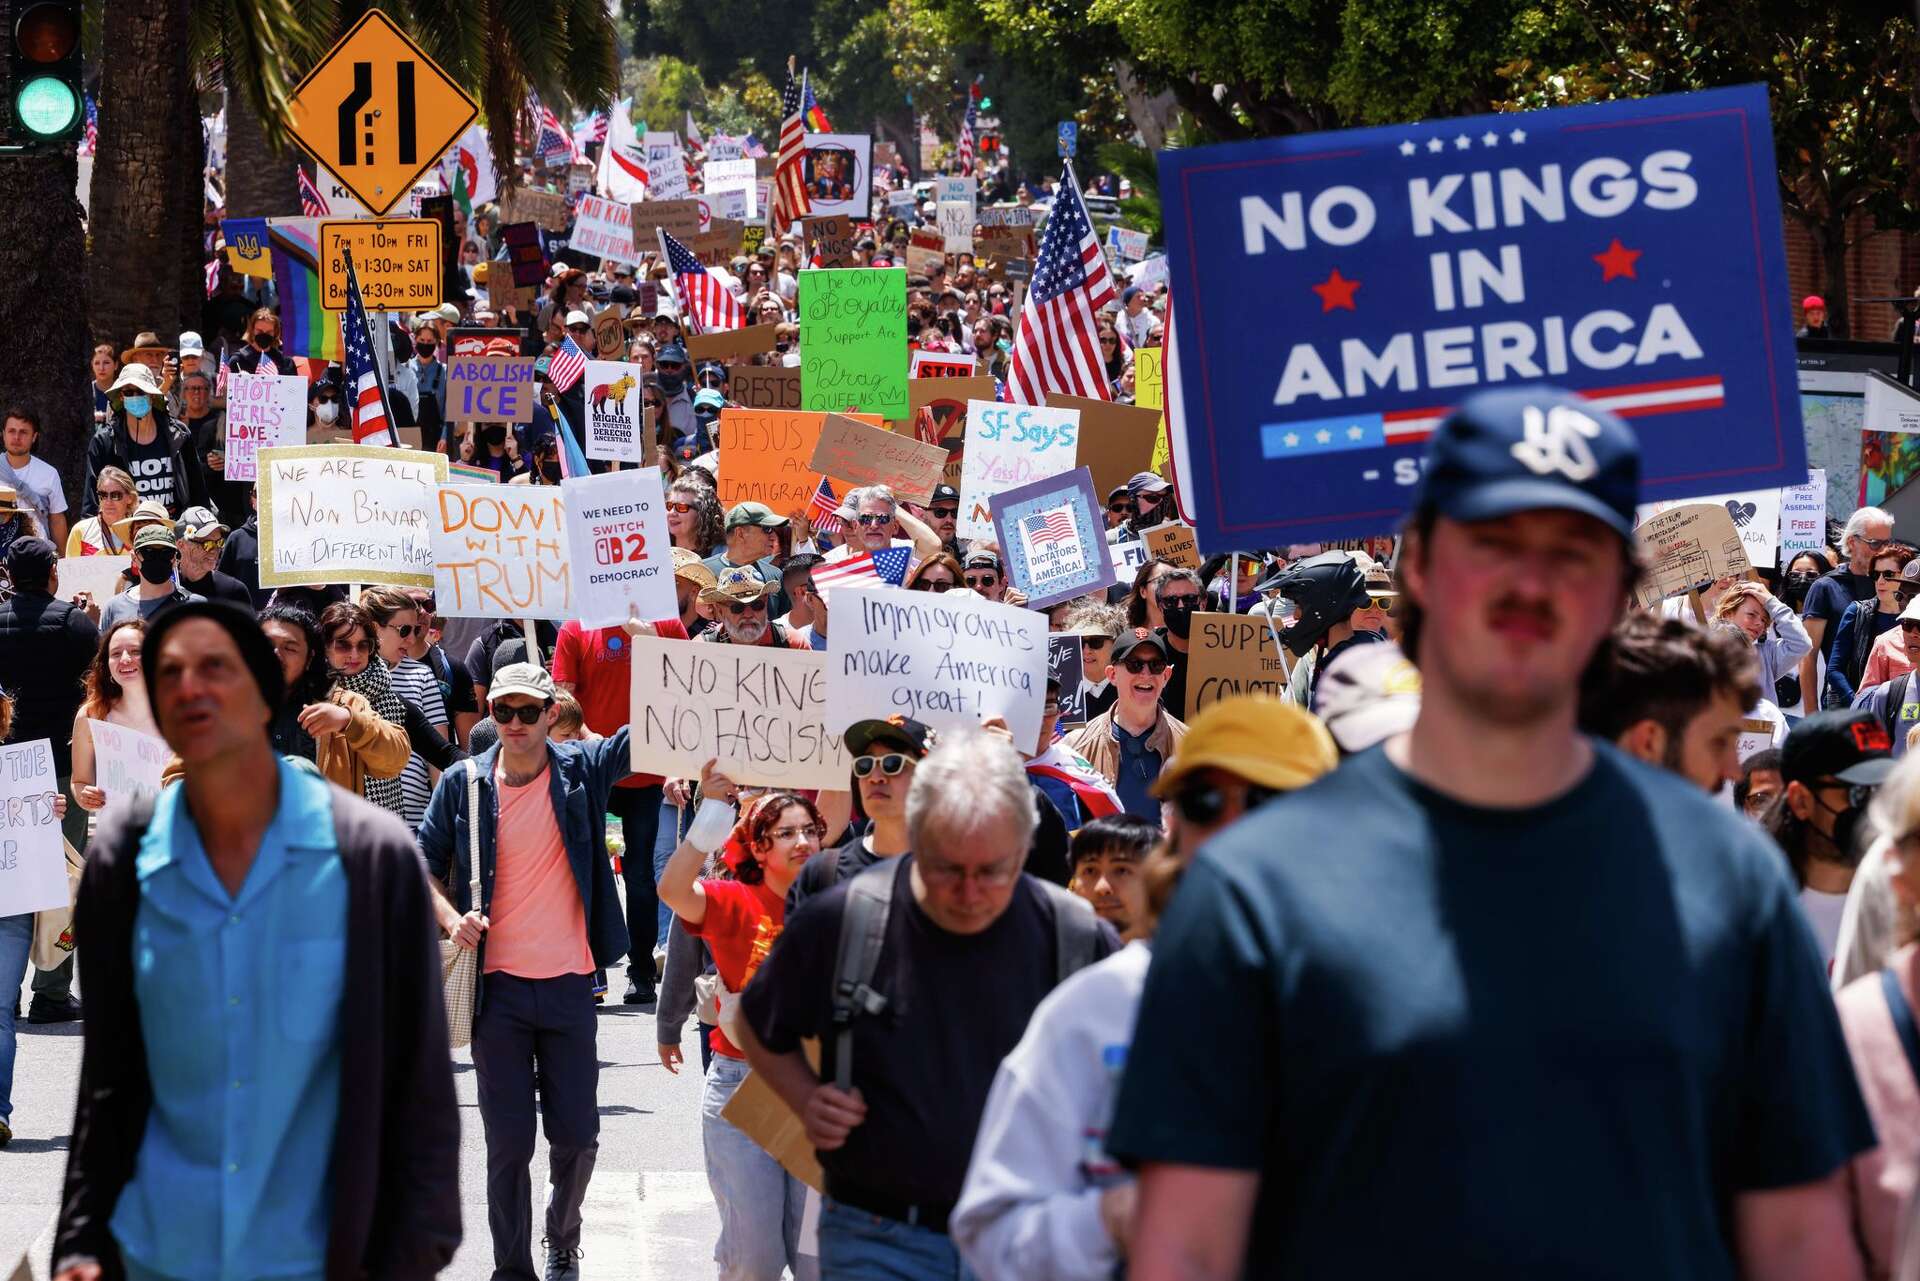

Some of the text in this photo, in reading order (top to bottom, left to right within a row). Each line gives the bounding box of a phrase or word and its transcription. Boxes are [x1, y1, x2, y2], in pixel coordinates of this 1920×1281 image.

[583, 199, 602, 218] NO
[1239, 149, 1698, 255] NO KINGS
[812, 220, 838, 237] NO
[333, 234, 351, 249] 7PM
[371, 233, 398, 249] 10PM
[407, 234, 428, 249] FRI
[364, 258, 403, 273] 1:30PM
[408, 259, 430, 273] SAT
[800, 269, 889, 294] The Only
[1430, 244, 1525, 311] IN
[362, 283, 404, 298] 4:30PM
[409, 284, 433, 298] SUN
[803, 325, 897, 347] I Support Are
[1273, 303, 1704, 406] AMERICA
[451, 362, 533, 383] ABOLISH
[806, 356, 889, 391] Drag
[920, 364, 969, 378] STOP
[233, 379, 274, 402] HOT
[463, 385, 517, 416] ICE
[732, 375, 801, 407] RESIS
[809, 392, 873, 412] QUEENS
[229, 402, 281, 427] GIRLS
[592, 413, 632, 424] MIGRAR
[229, 423, 267, 441] LOVE
[593, 428, 632, 438] DERECHO
[602, 422, 632, 430] NUESTRO
[727, 417, 802, 451] JESUS
[979, 409, 1075, 452] SF Says
[594, 436, 632, 444] ANCESTRAL
[128, 457, 173, 477] NOT
[226, 462, 257, 480] NEI
[276, 459, 427, 486] WE ARE ALL
[781, 457, 812, 473] AN
[943, 464, 961, 478] KIN
[722, 477, 813, 502] IMMIGRAN
[583, 502, 649, 520] WE NEED TO
[592, 520, 645, 536] SWITCH
[1791, 519, 1816, 530] FREE
[626, 533, 649, 562] 2
[1045, 542, 1059, 551] NO
[1164, 532, 1177, 543] DO
[1784, 538, 1824, 550] KHALIL!
[279, 534, 433, 567] IN DIFFERENT WAYS
[1031, 545, 1078, 566] DICTATORS
[1035, 560, 1082, 582] AMERICA!
[1051, 558, 1061, 568] IN
[590, 566, 660, 584] DEMOCRACY
[436, 557, 570, 614] TRUM
[862, 596, 1034, 651] Immigrants
[844, 649, 1032, 698] make America
[1260, 658, 1282, 671] THE
[664, 653, 826, 712] NO KING
[646, 704, 842, 767] NO FASCISM
[6, 744, 48, 782] THE
